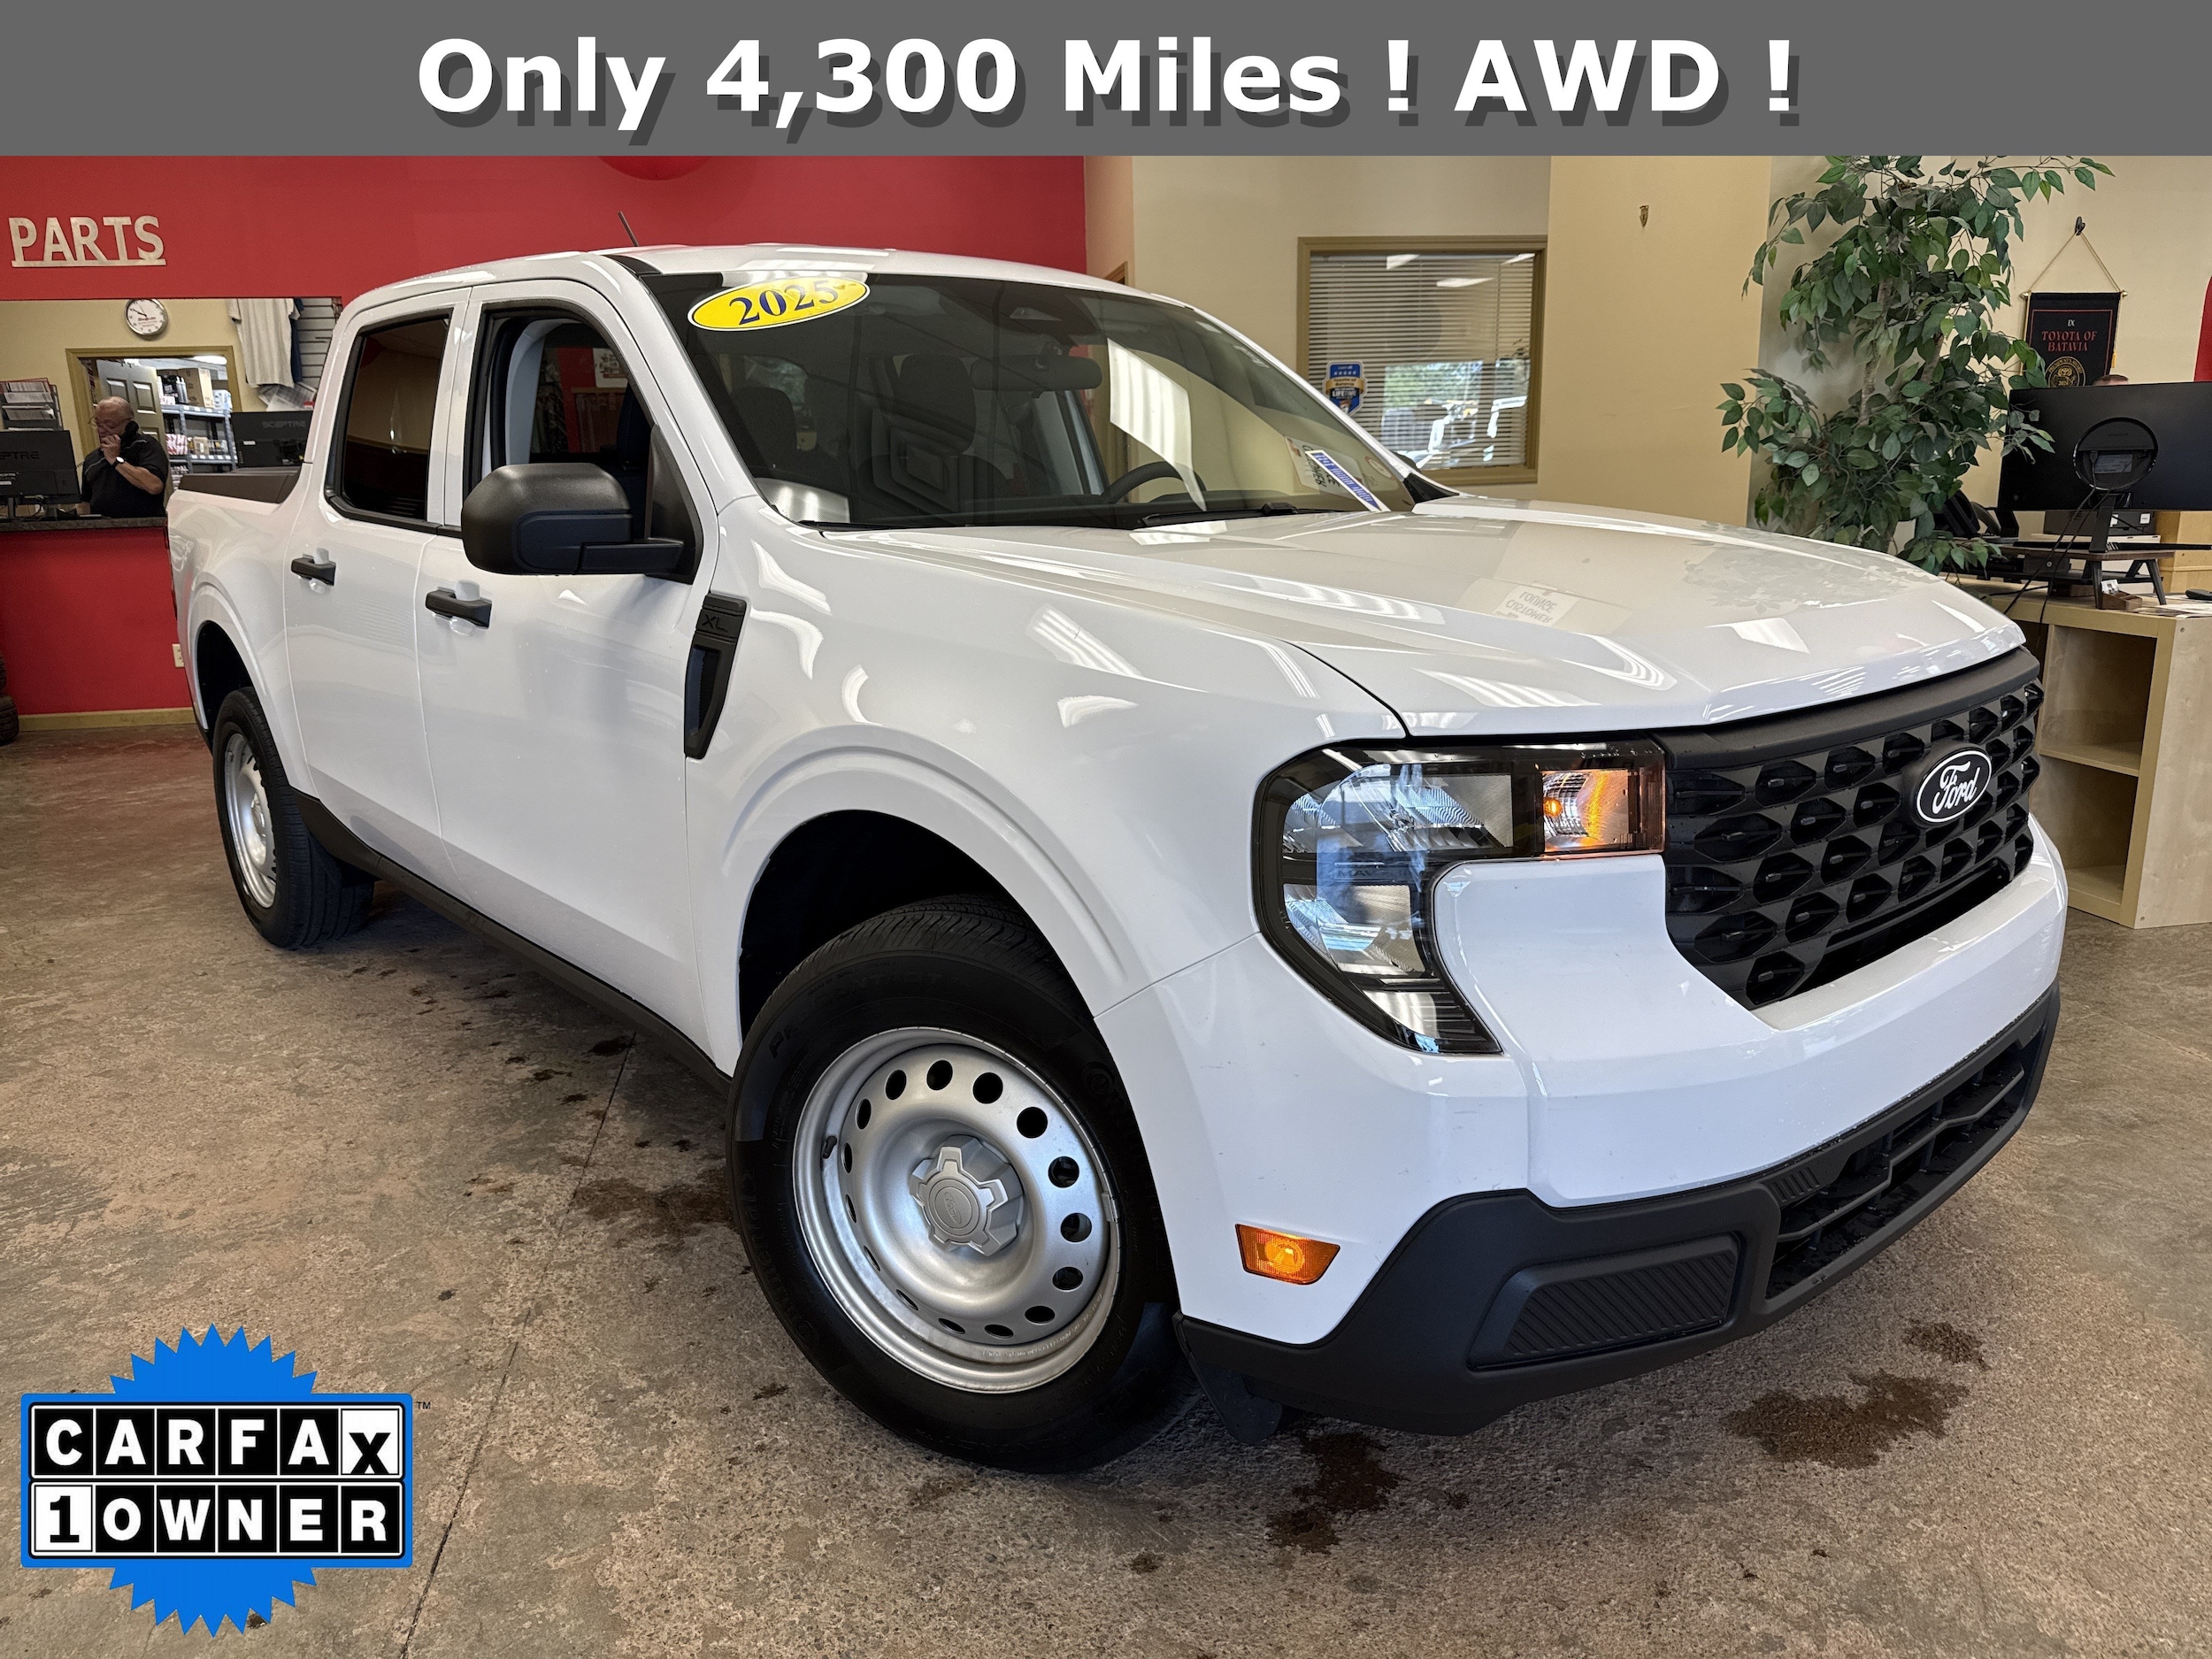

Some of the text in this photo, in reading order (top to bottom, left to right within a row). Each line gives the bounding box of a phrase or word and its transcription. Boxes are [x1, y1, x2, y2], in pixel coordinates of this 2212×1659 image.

[8, 215, 166, 267] PARTS
[729, 280, 840, 326] 2025
[2042, 331, 2098, 342] TOYOTA OF
[2047, 342, 2088, 352] BATAVIA
[702, 613, 728, 633] XL
[1932, 761, 1981, 814] Ford
